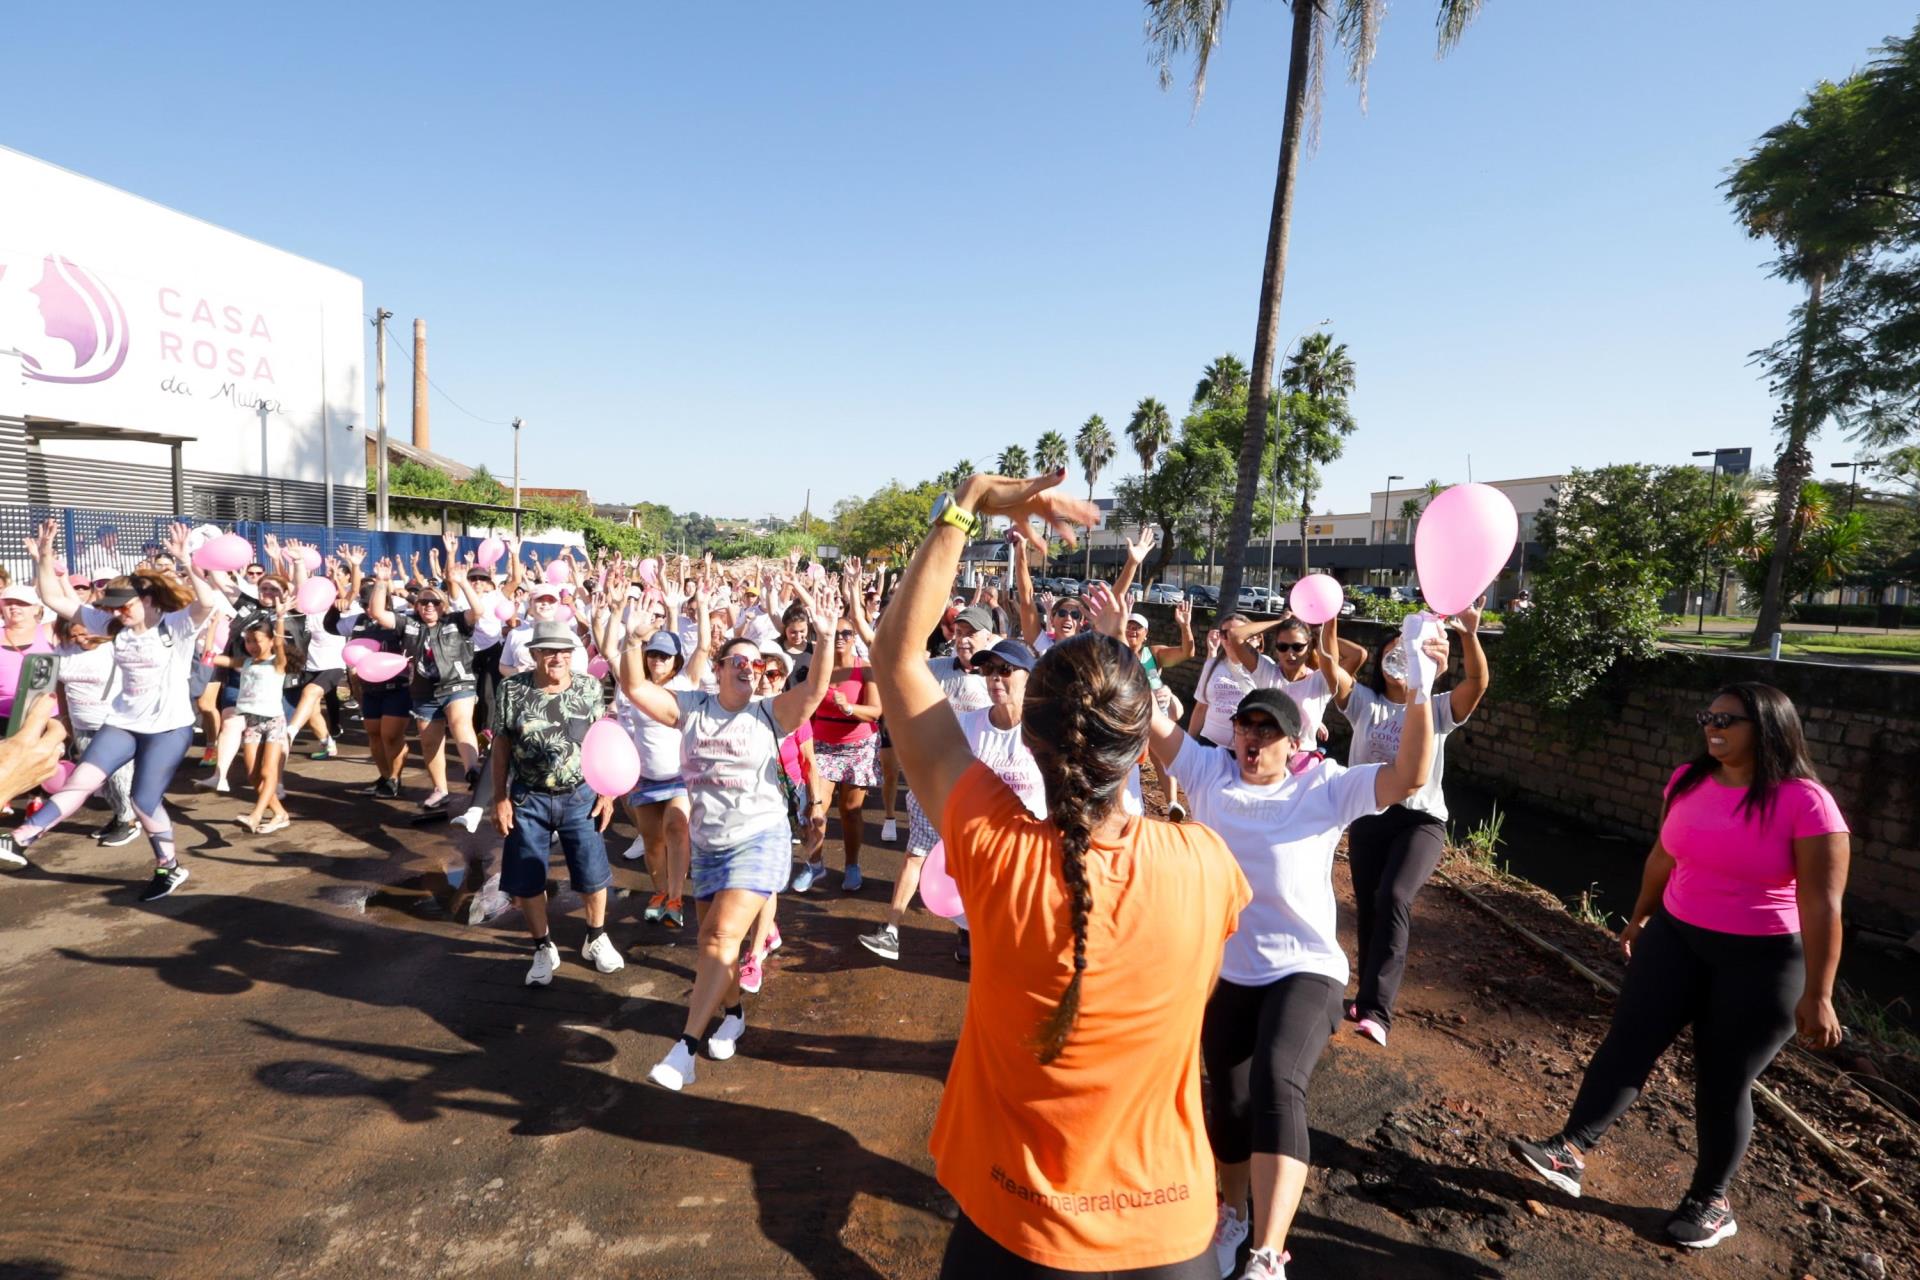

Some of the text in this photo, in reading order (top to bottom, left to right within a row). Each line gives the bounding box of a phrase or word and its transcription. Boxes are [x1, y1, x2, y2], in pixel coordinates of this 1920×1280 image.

[158, 287, 272, 343] CASA
[160, 330, 276, 384] ROSA
[160, 375, 192, 396] da
[990, 1163, 1190, 1216] #teamnajaralouzada
